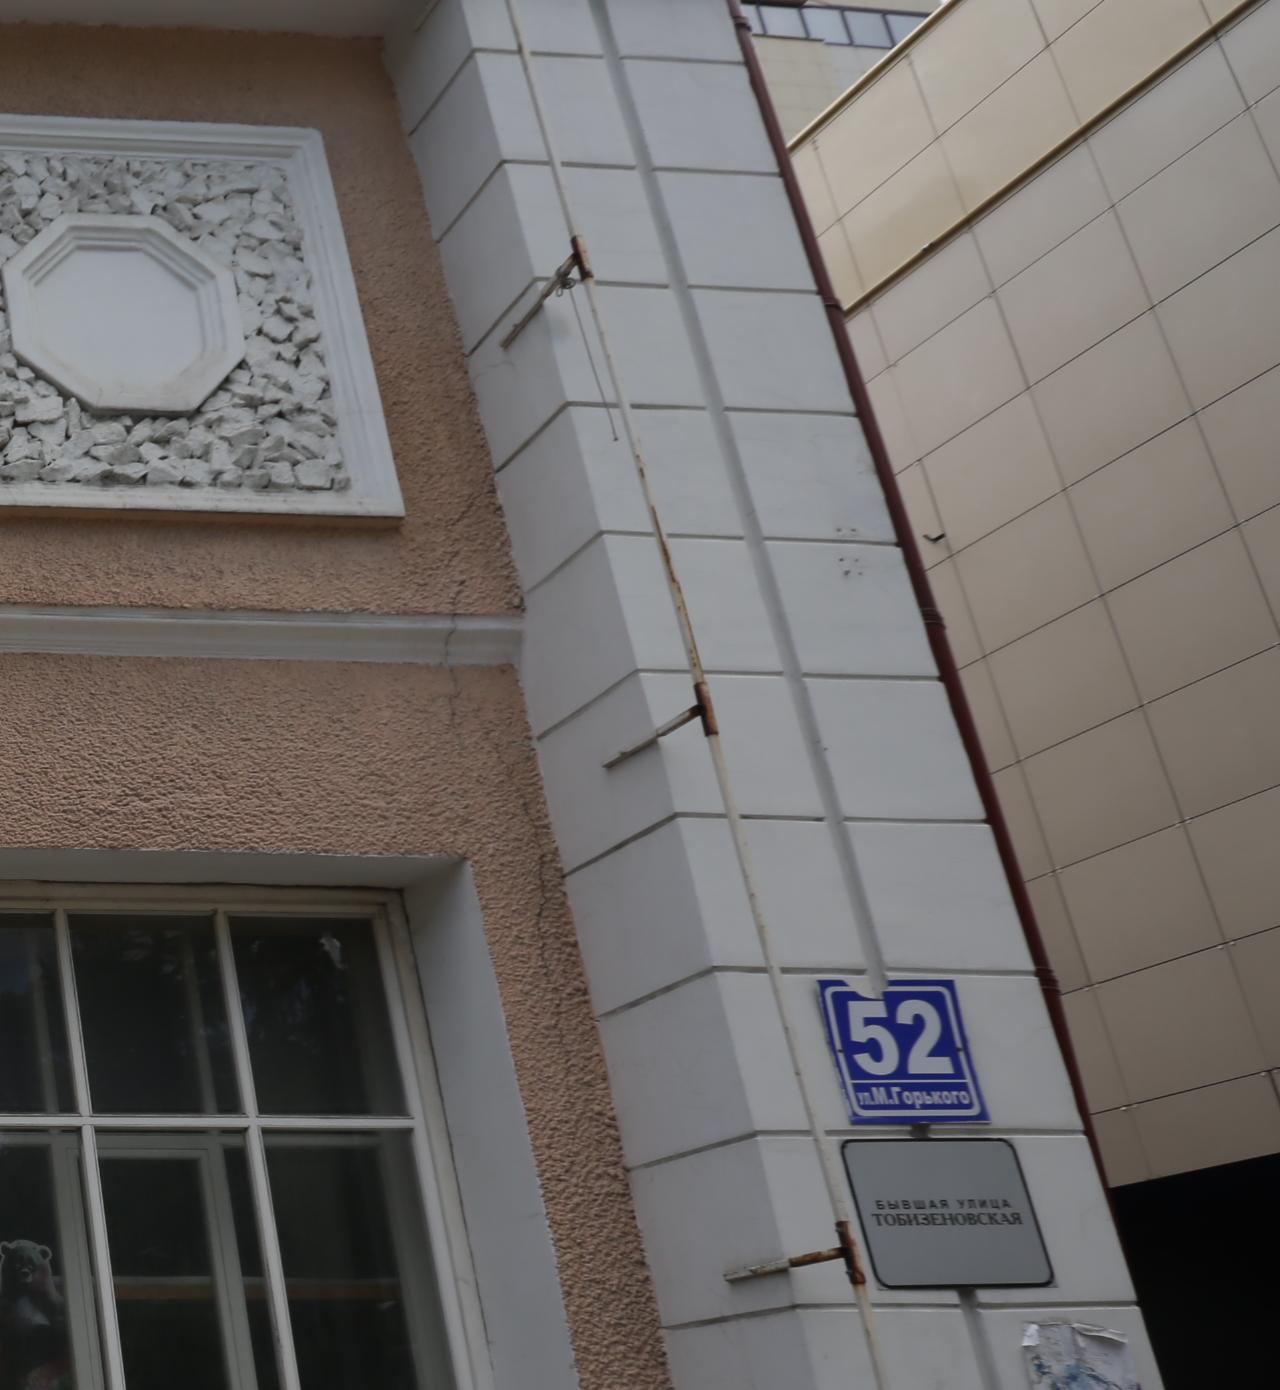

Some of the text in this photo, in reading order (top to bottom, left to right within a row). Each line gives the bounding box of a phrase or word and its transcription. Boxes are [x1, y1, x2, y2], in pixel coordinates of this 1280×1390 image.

[846, 998, 956, 1077] 52
[875, 1198, 1012, 1211] БЫВШАЯ УЛИЦА
[871, 1212, 1024, 1227] ТОБИЗЕНОВСКАЯ
